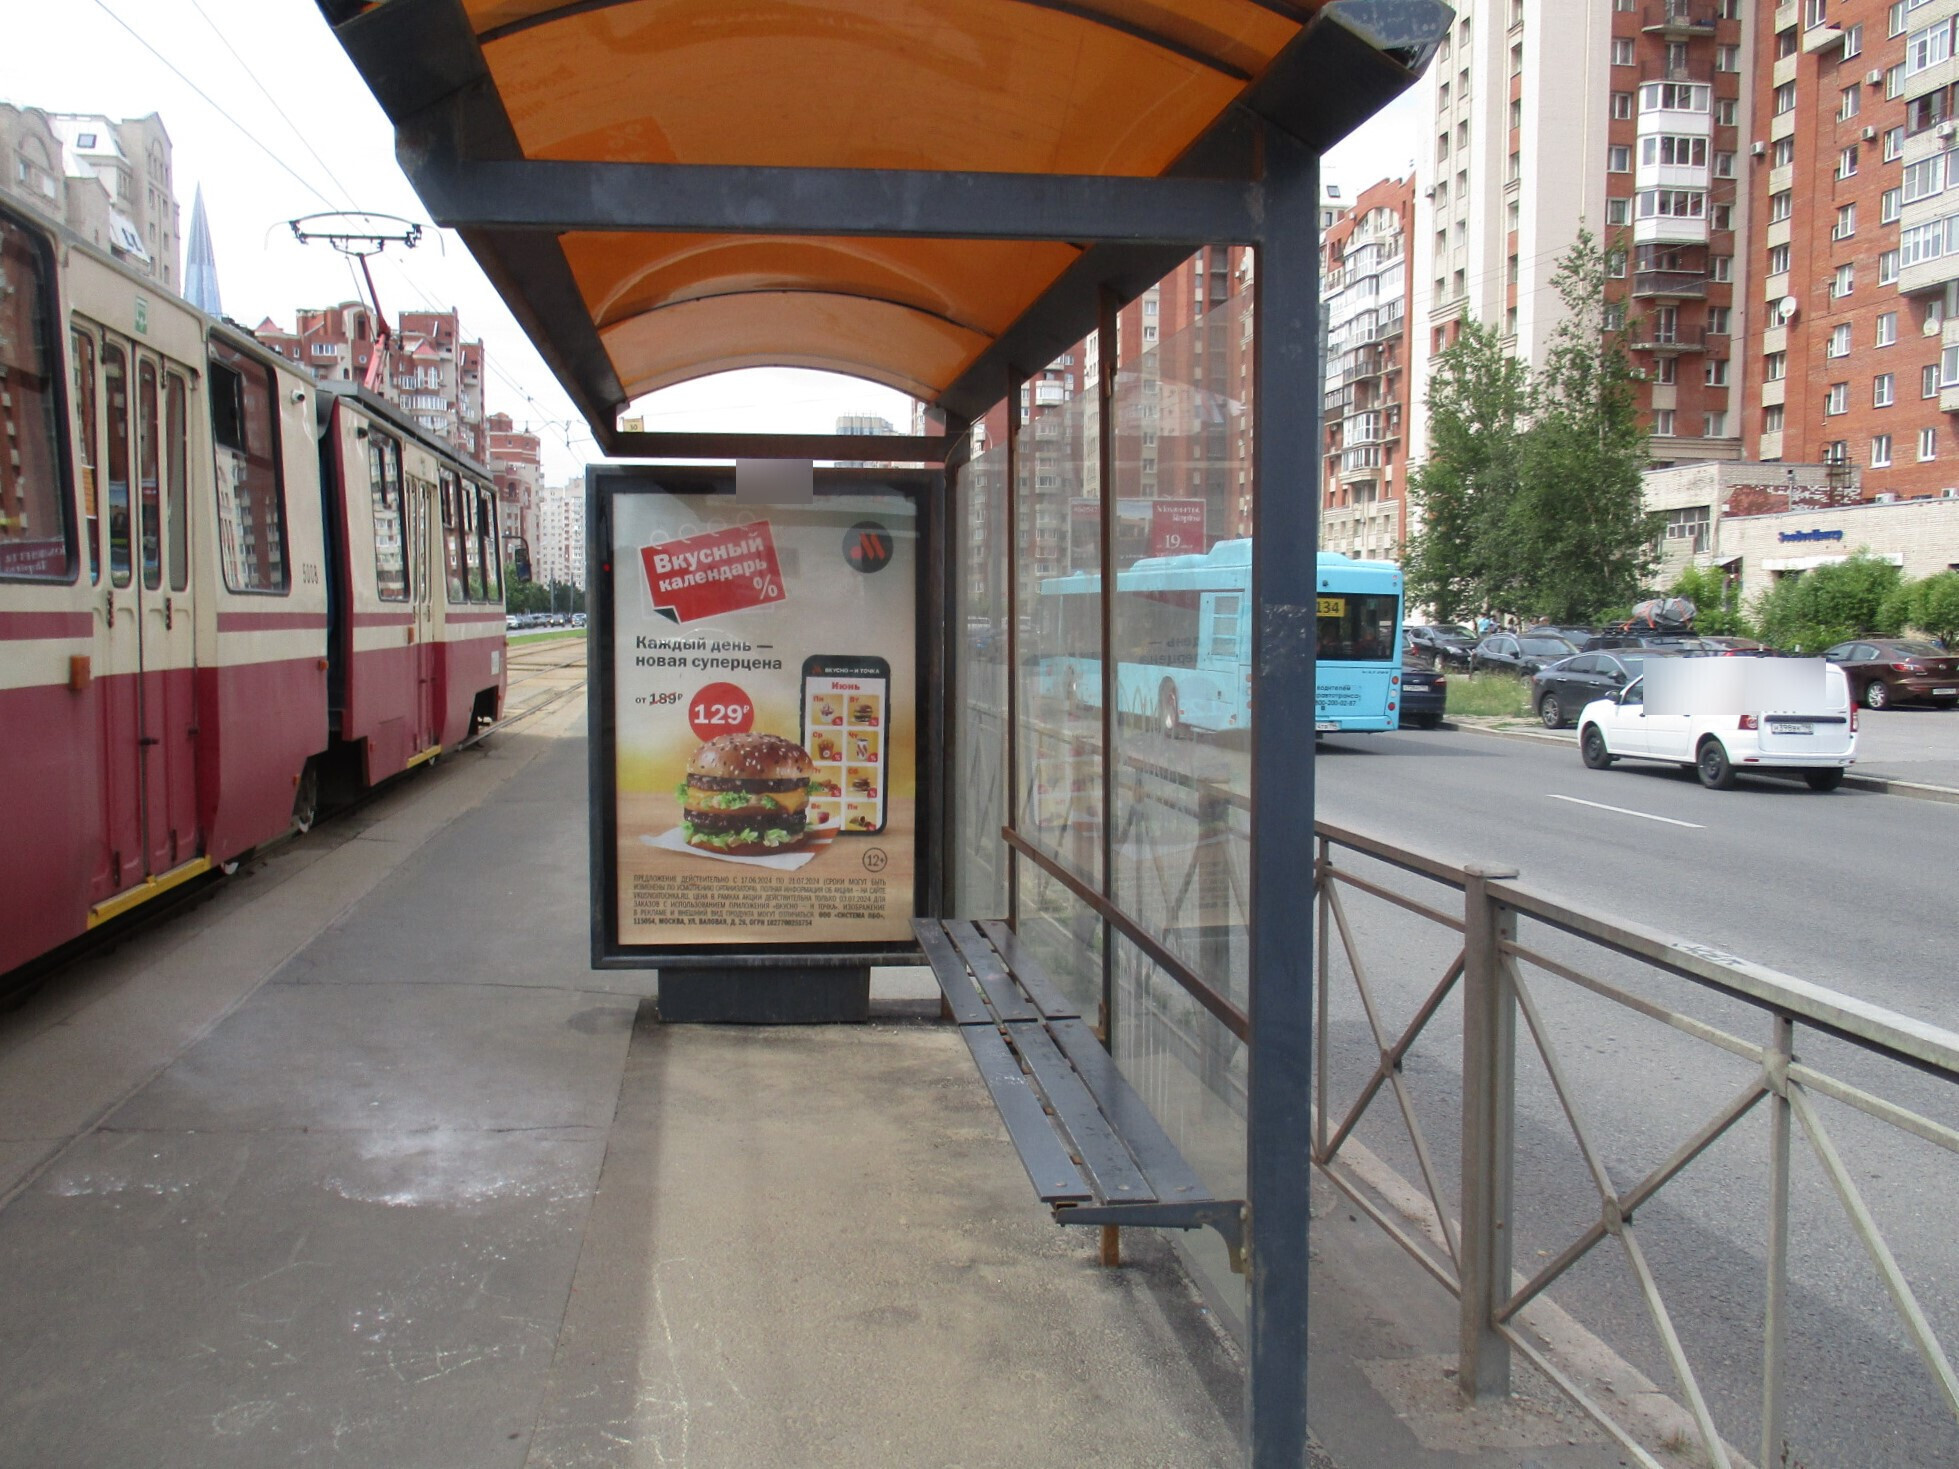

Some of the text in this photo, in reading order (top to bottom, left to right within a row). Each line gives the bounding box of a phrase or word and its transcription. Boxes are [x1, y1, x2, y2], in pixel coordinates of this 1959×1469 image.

[652, 532, 764, 575] Вкусный
[658, 557, 768, 593] календарь
[636, 635, 706, 652] Каждый
[711, 640, 752, 652] день
[635, 656, 782, 671] новая суперцена
[831, 681, 860, 691] Июнь
[867, 854, 885, 866] 12+
[634, 875, 677, 883] ПРЕДЛОЖЕНИЕ
[871, 878, 886, 886] БЫТЬ
[717, 893, 740, 901] РАМКАХ
